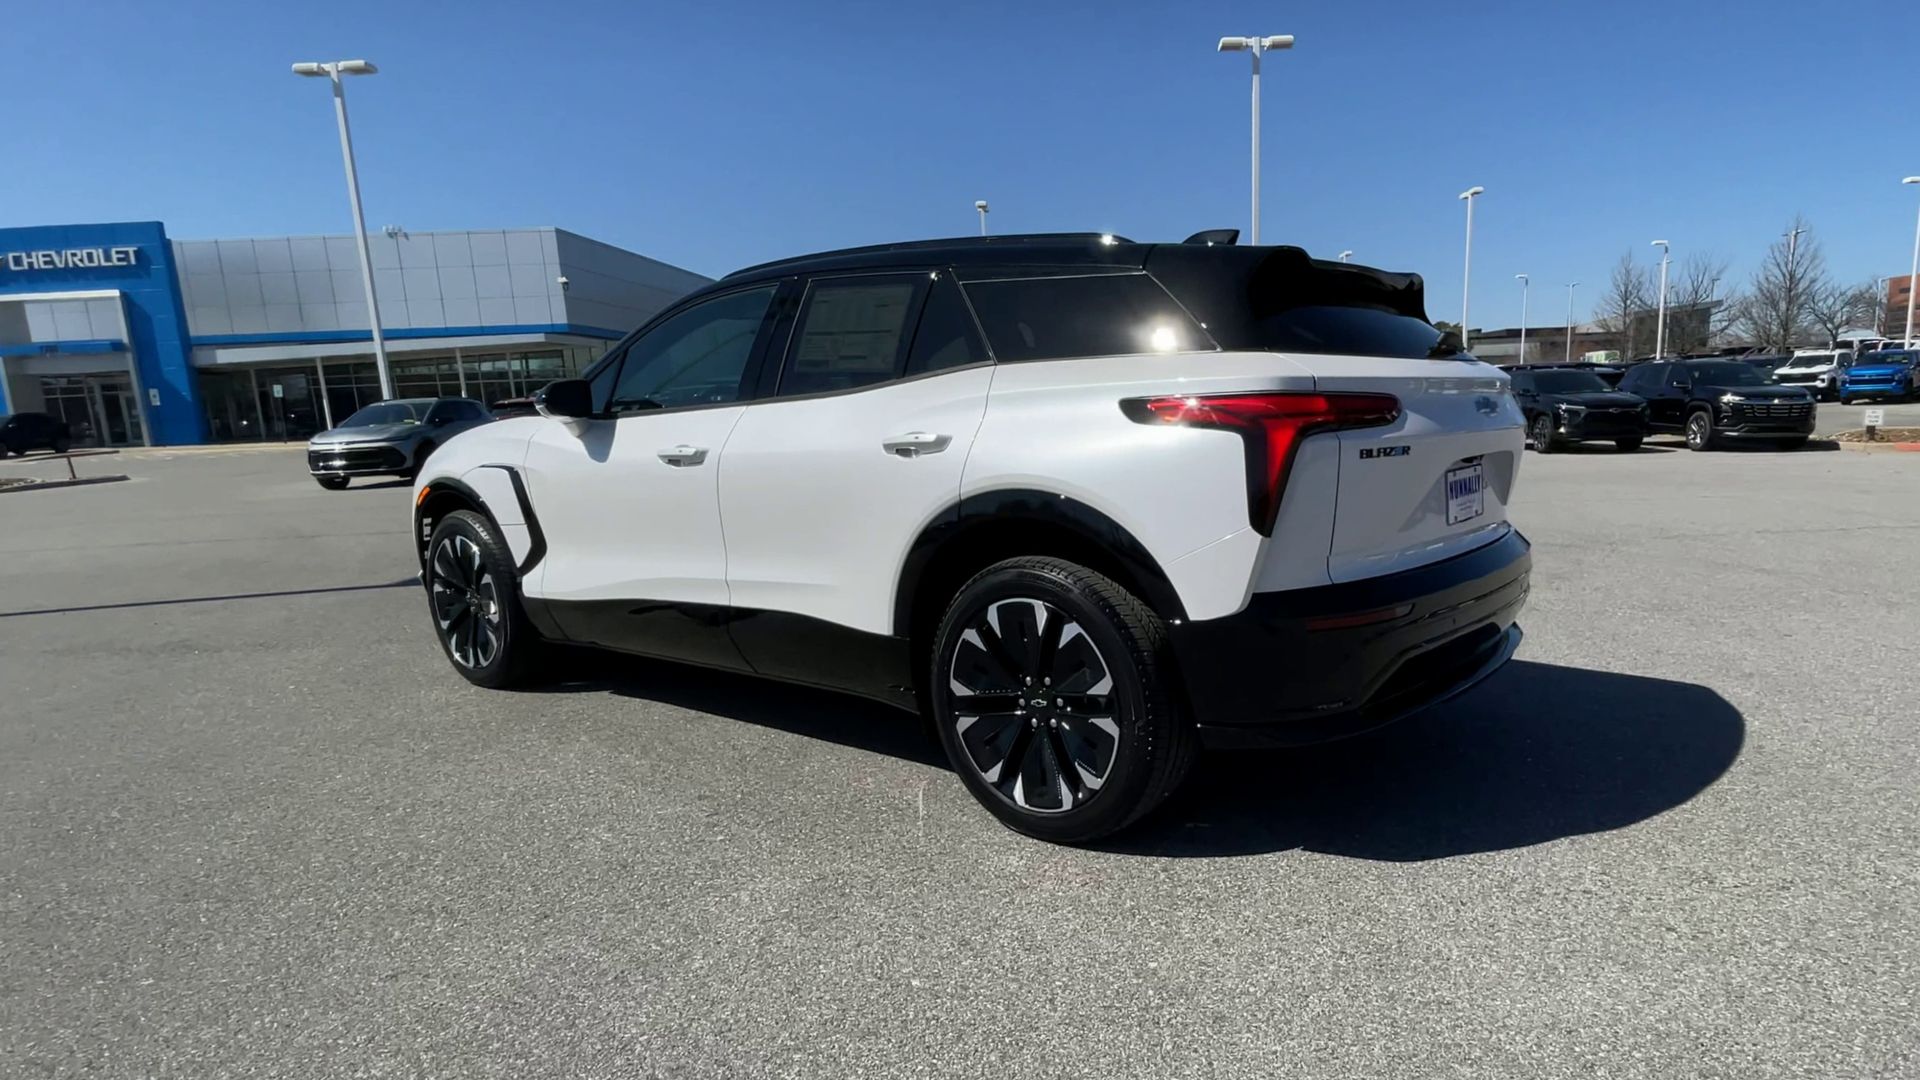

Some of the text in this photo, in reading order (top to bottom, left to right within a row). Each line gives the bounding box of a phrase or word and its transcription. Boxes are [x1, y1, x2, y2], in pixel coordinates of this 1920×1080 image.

[8, 247, 138, 271] CHEVROLET
[1359, 445, 1411, 460] BLAZER
[1449, 474, 1481, 501] NUNNALLY
